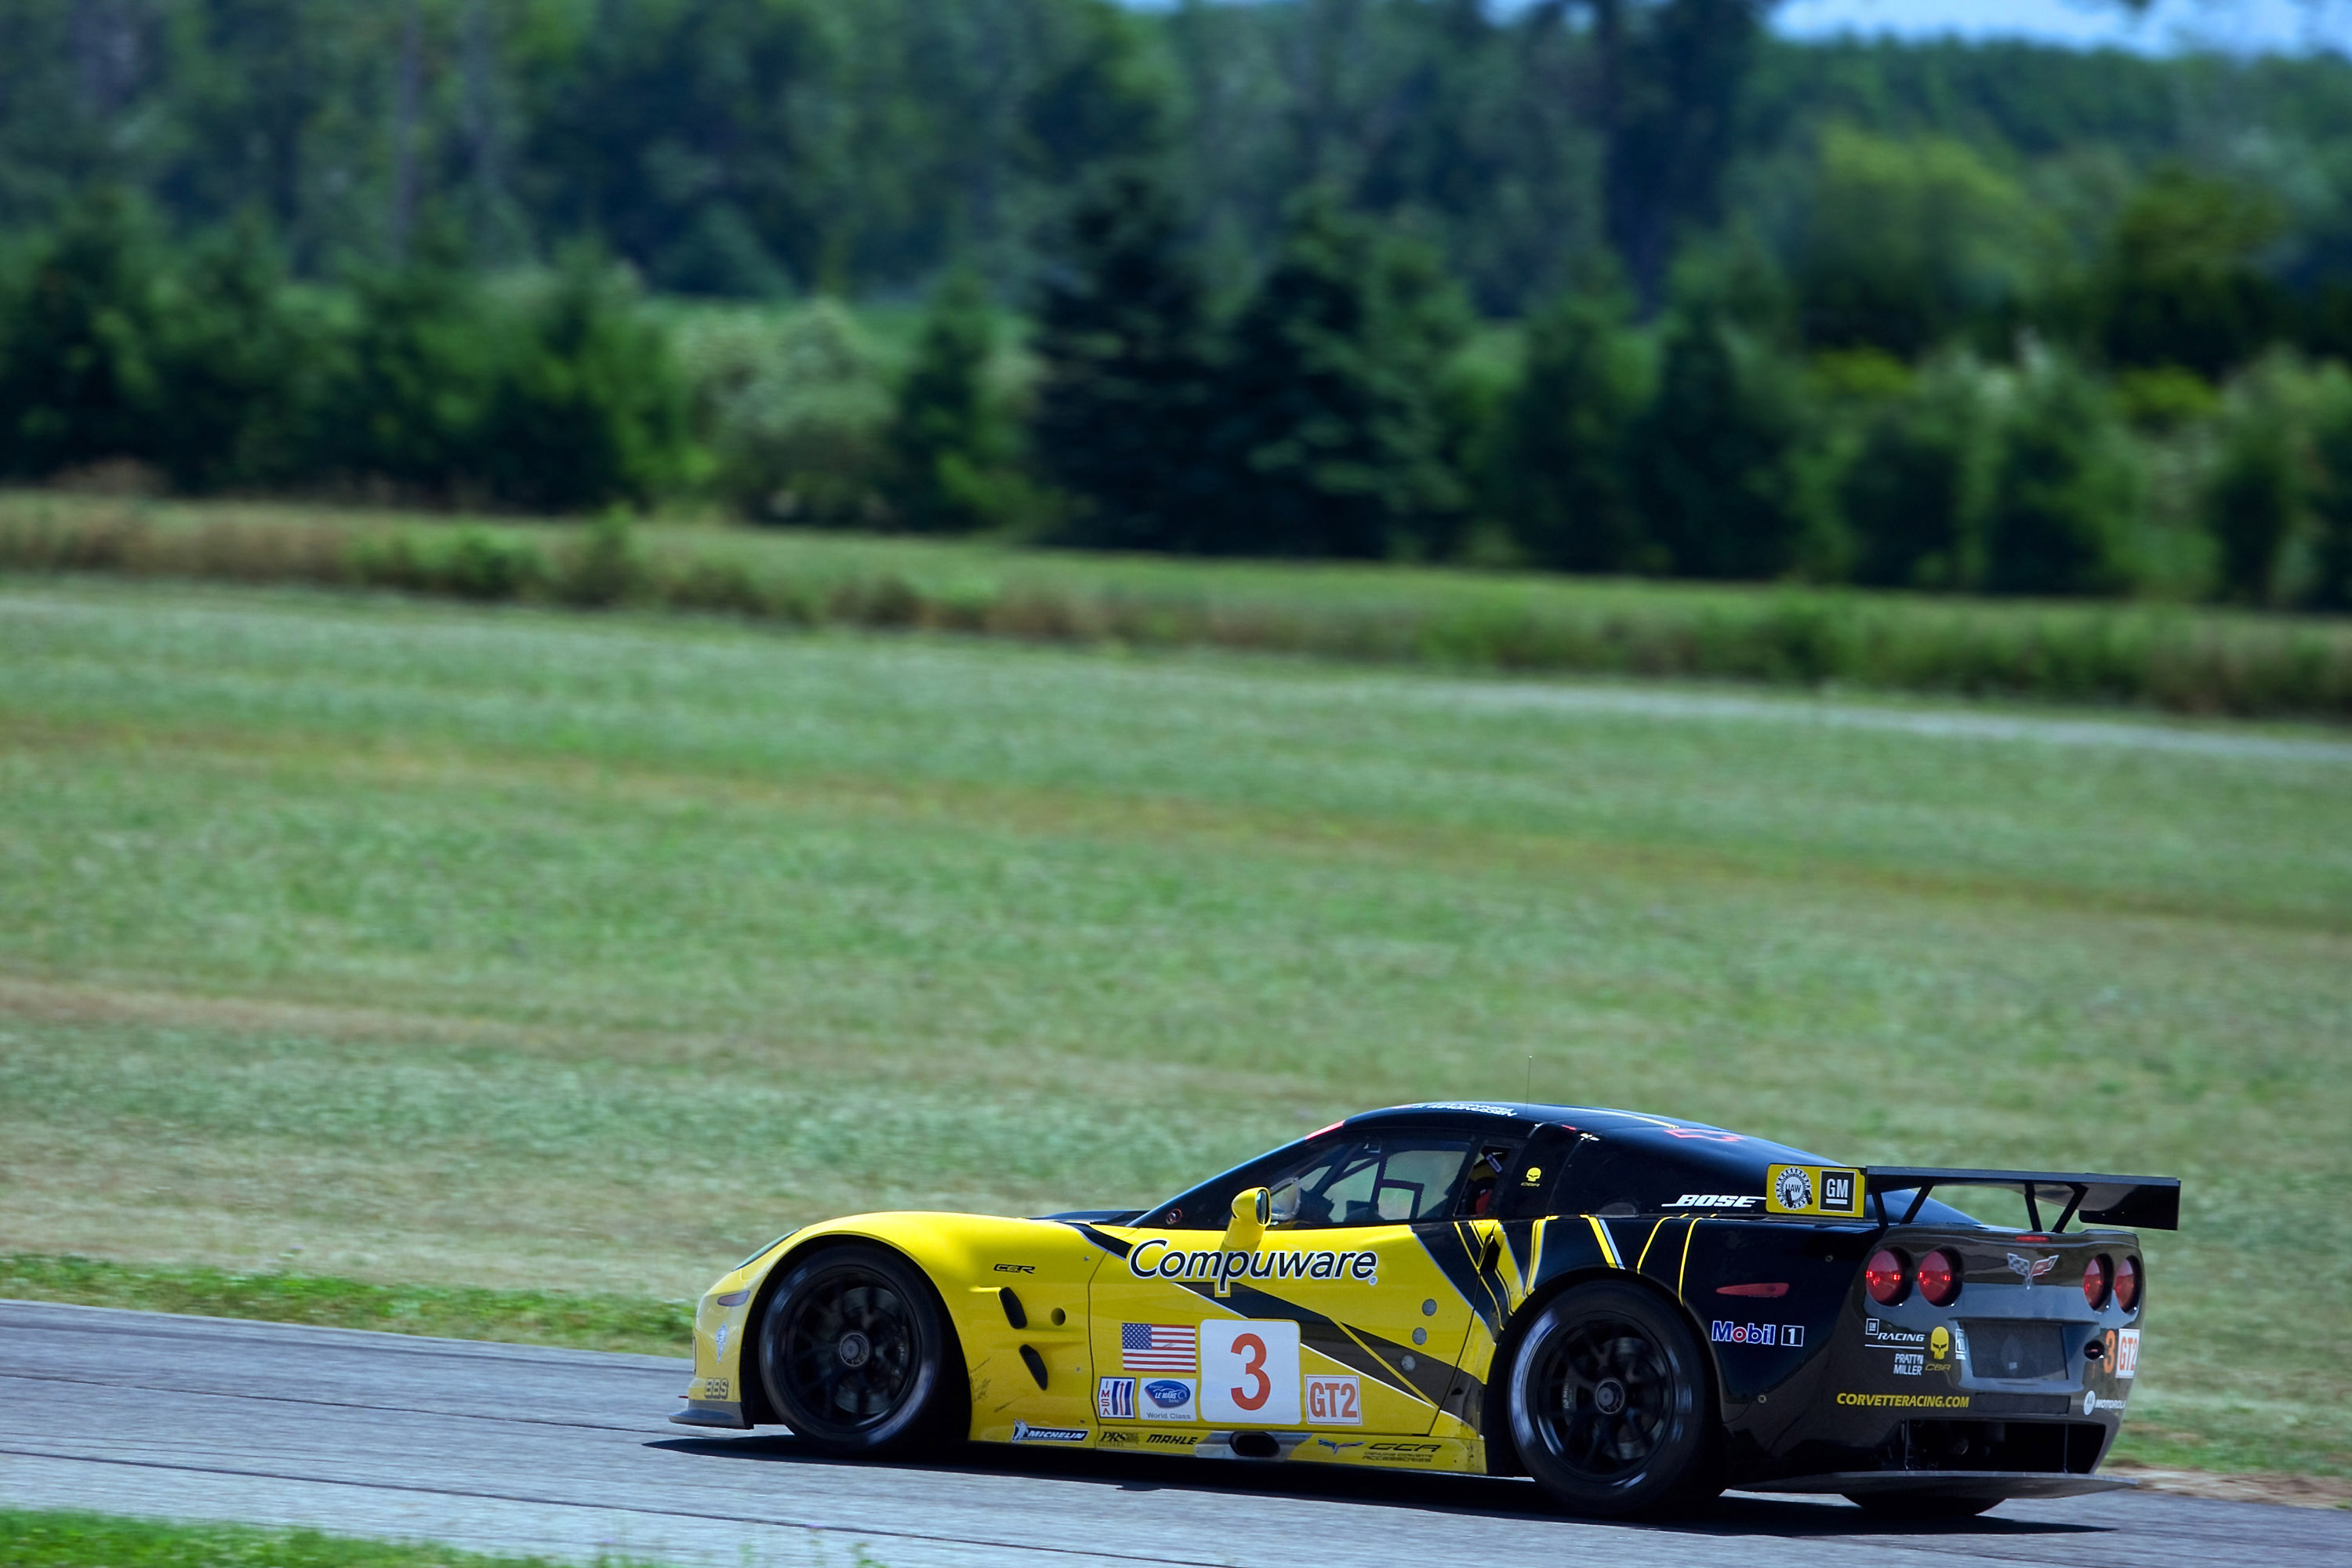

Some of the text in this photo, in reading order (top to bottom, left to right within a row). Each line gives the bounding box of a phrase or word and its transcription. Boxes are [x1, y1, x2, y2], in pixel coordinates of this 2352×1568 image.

[1785, 1184, 1802, 1193] UAW
[1826, 1178, 1849, 1198] GM
[1661, 1194, 1766, 1207] BOSE
[1130, 1240, 1377, 1293] Compuware
[1711, 1320, 1776, 1345] Mobil
[1878, 1332, 1925, 1341] RACING
[2103, 1330, 2115, 1374] 3
[2119, 1336, 2138, 1371] GT2
[1231, 1333, 1271, 1410] 3
[1893, 1364, 1922, 1376] MILLER
[704, 1377, 728, 1399] BBS
[1101, 1381, 1110, 1415] IMSA
[1309, 1381, 1357, 1417] GT2
[1837, 1392, 1969, 1408] CORVETTERACING.COM
[1028, 1430, 1085, 1439] MICHELIN
[1100, 1432, 1128, 1442] PRS
[1146, 1434, 1198, 1445] MAHLE
